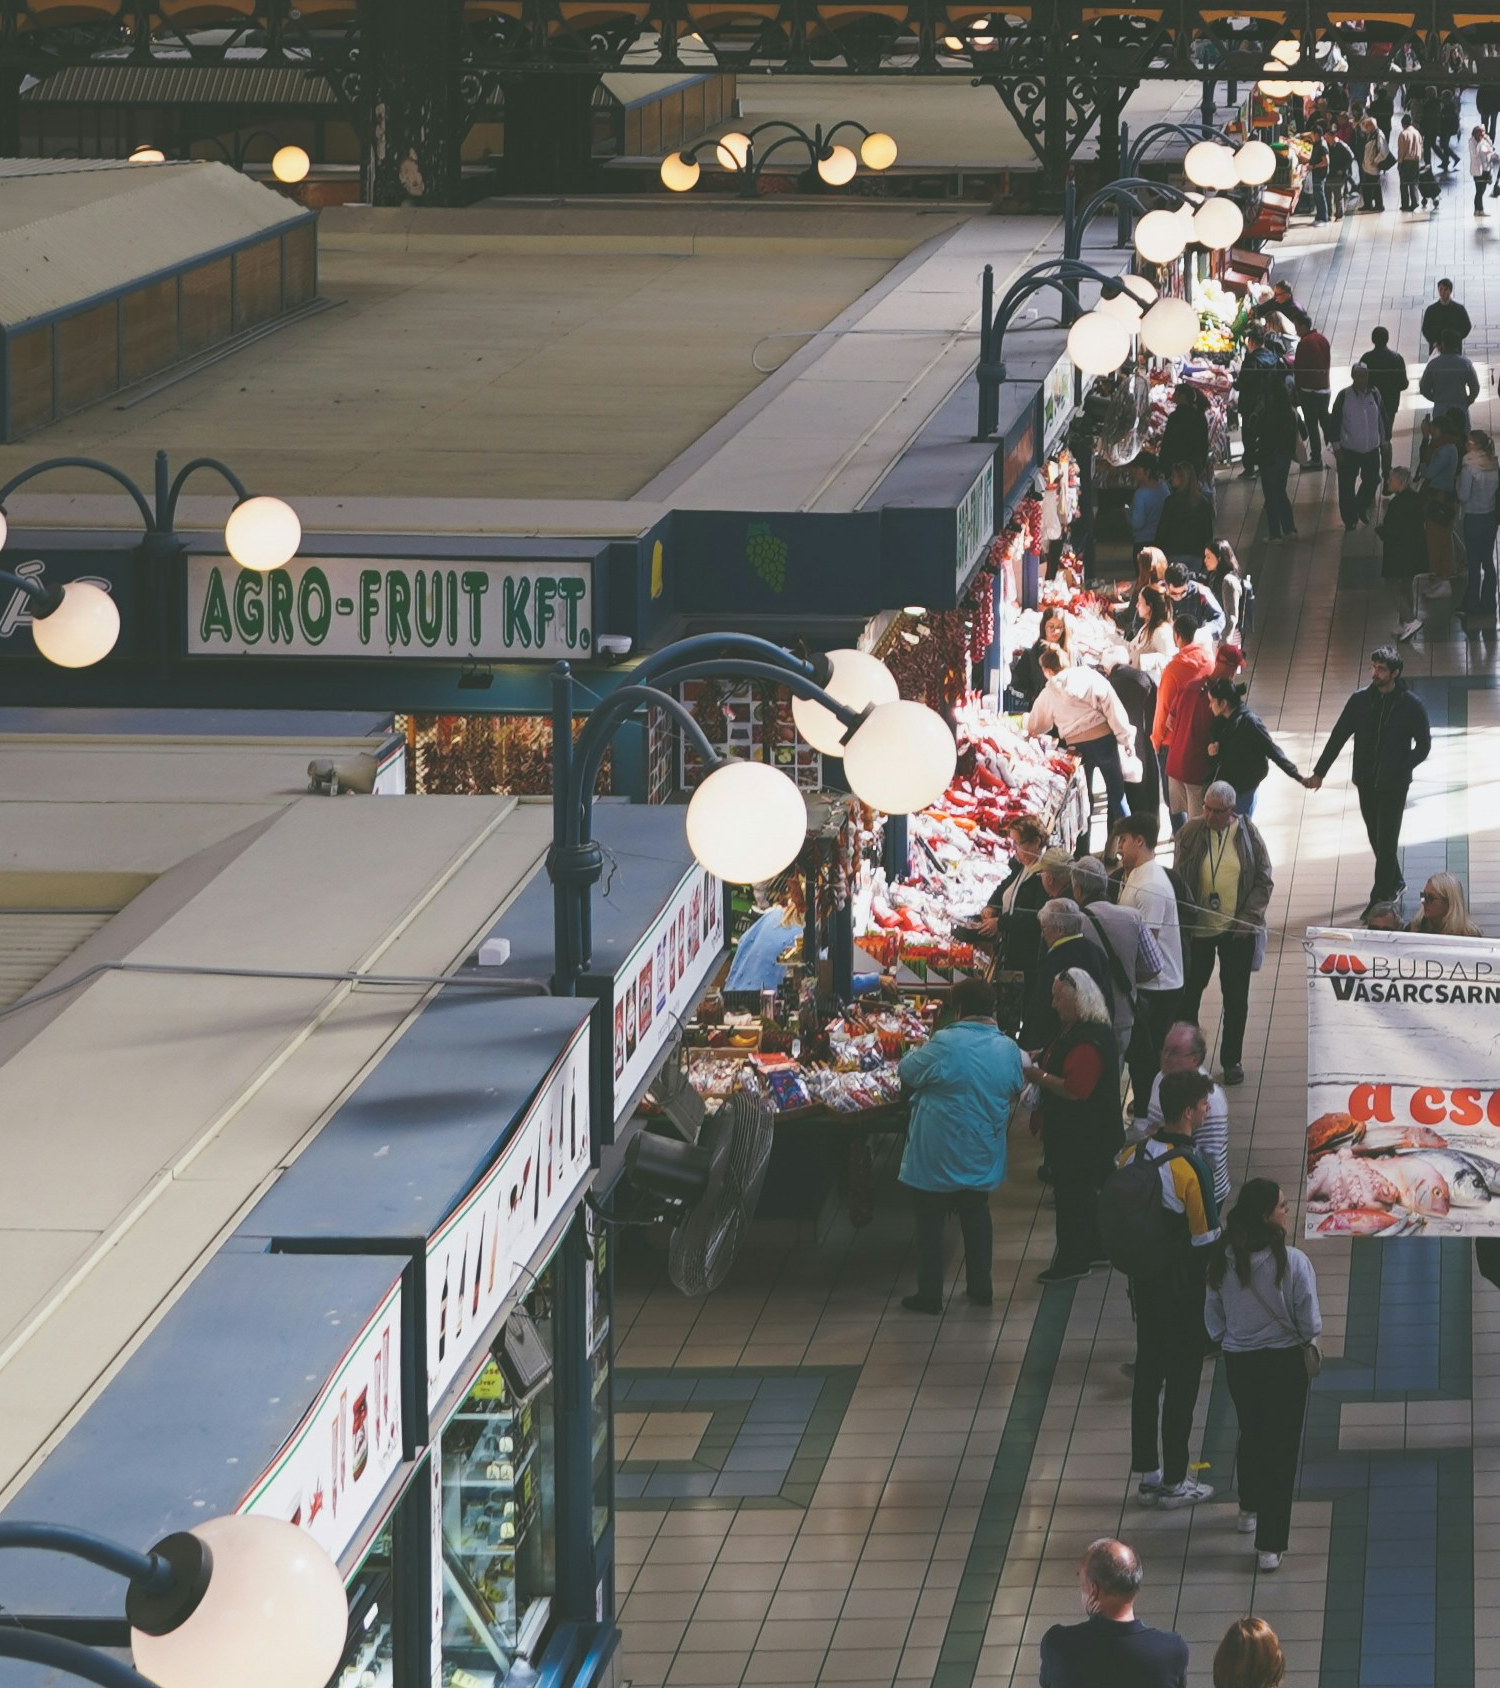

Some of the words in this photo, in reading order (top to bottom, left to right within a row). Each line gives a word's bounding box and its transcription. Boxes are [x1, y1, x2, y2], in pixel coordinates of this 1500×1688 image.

[200, 566, 489, 648] AGRO-FRUIT
[502, 575, 592, 650] KFT.
[1347, 1085, 1395, 1124] a
